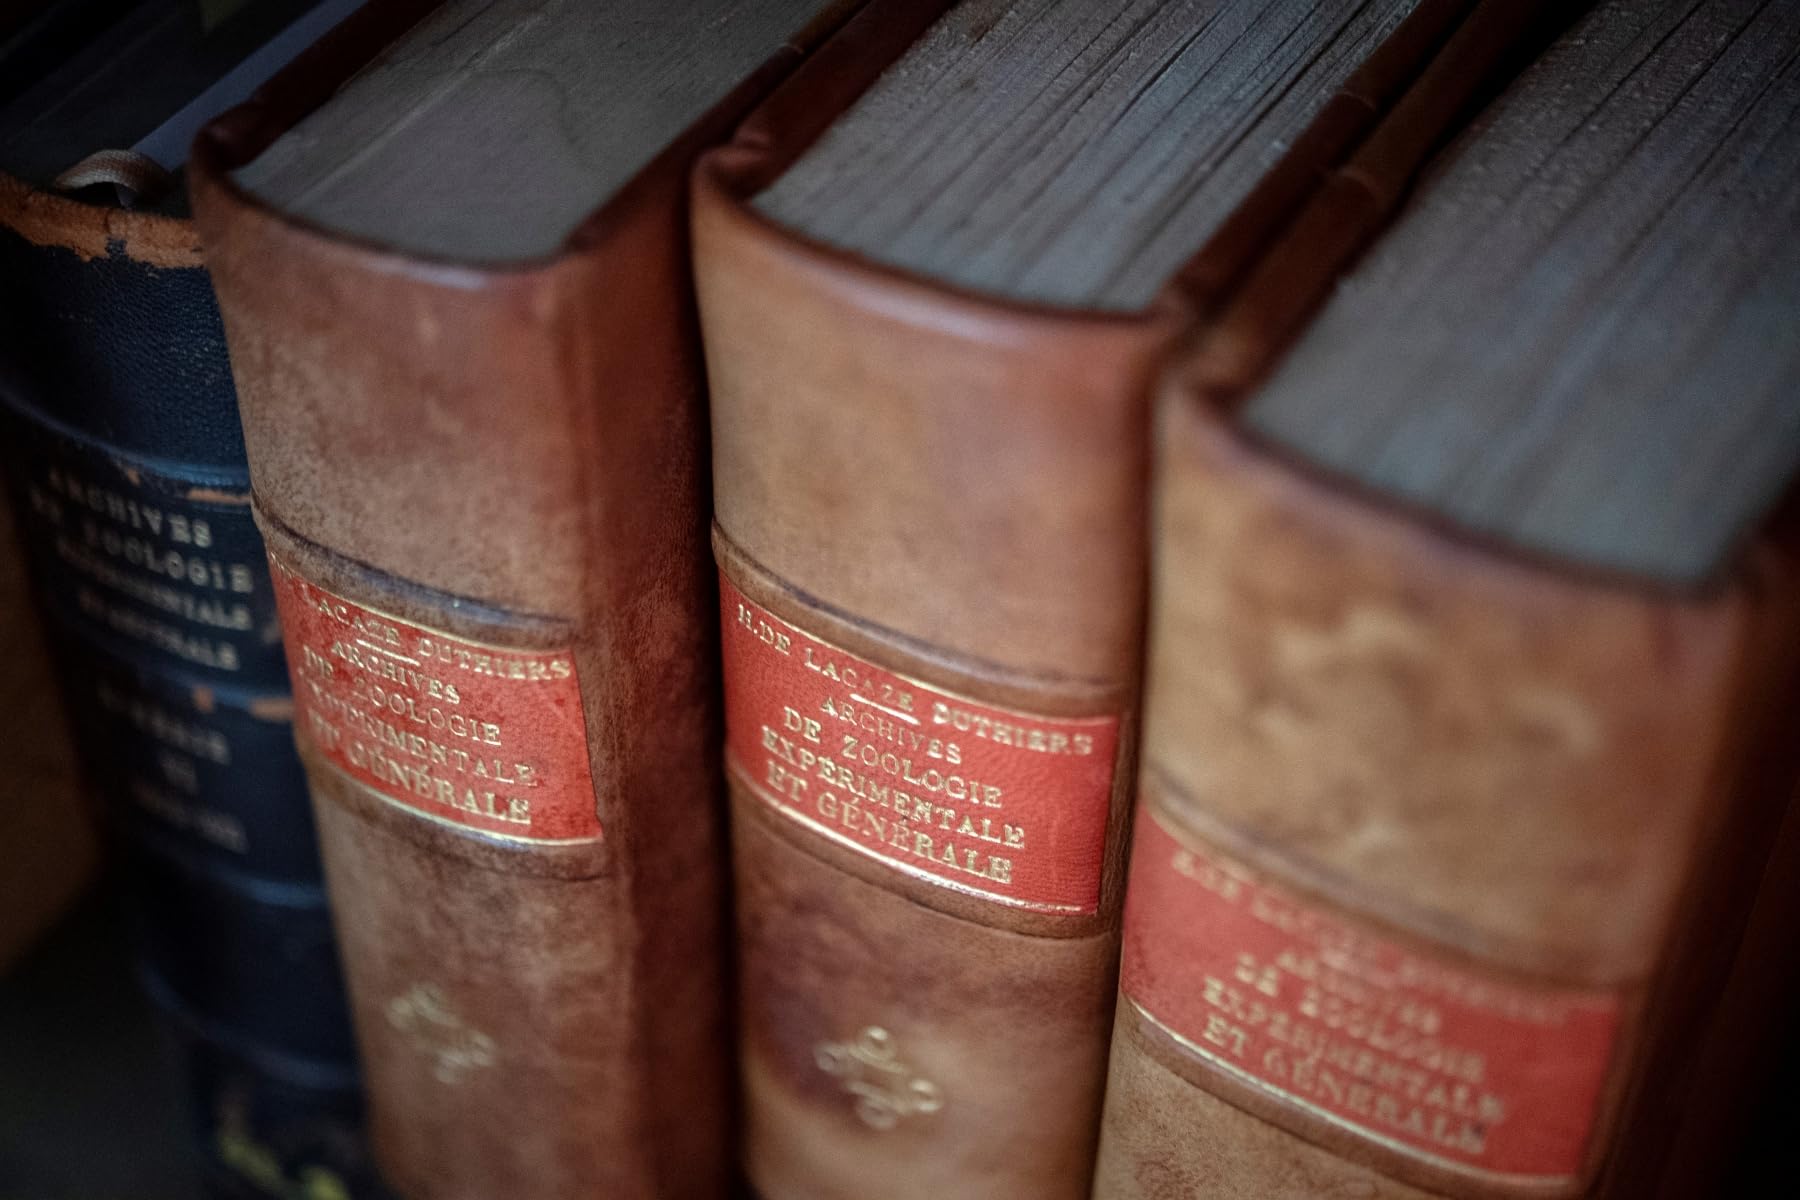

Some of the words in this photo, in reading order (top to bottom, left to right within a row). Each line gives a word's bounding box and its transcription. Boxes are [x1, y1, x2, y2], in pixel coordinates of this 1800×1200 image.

[331, 641, 460, 704] ARCHIVES
[351, 677, 501, 745] ZOOLOGIE
[820, 697, 962, 764] ARCHIVES
[932, 703, 1093, 755] DUTHIERS
[784, 705, 821, 743] DE
[841, 735, 1002, 808] ZOOLOGIE
[767, 760, 808, 801] ET
[816, 791, 1012, 884] GÉNÉRALE
[1203, 1014, 1247, 1057] ET
